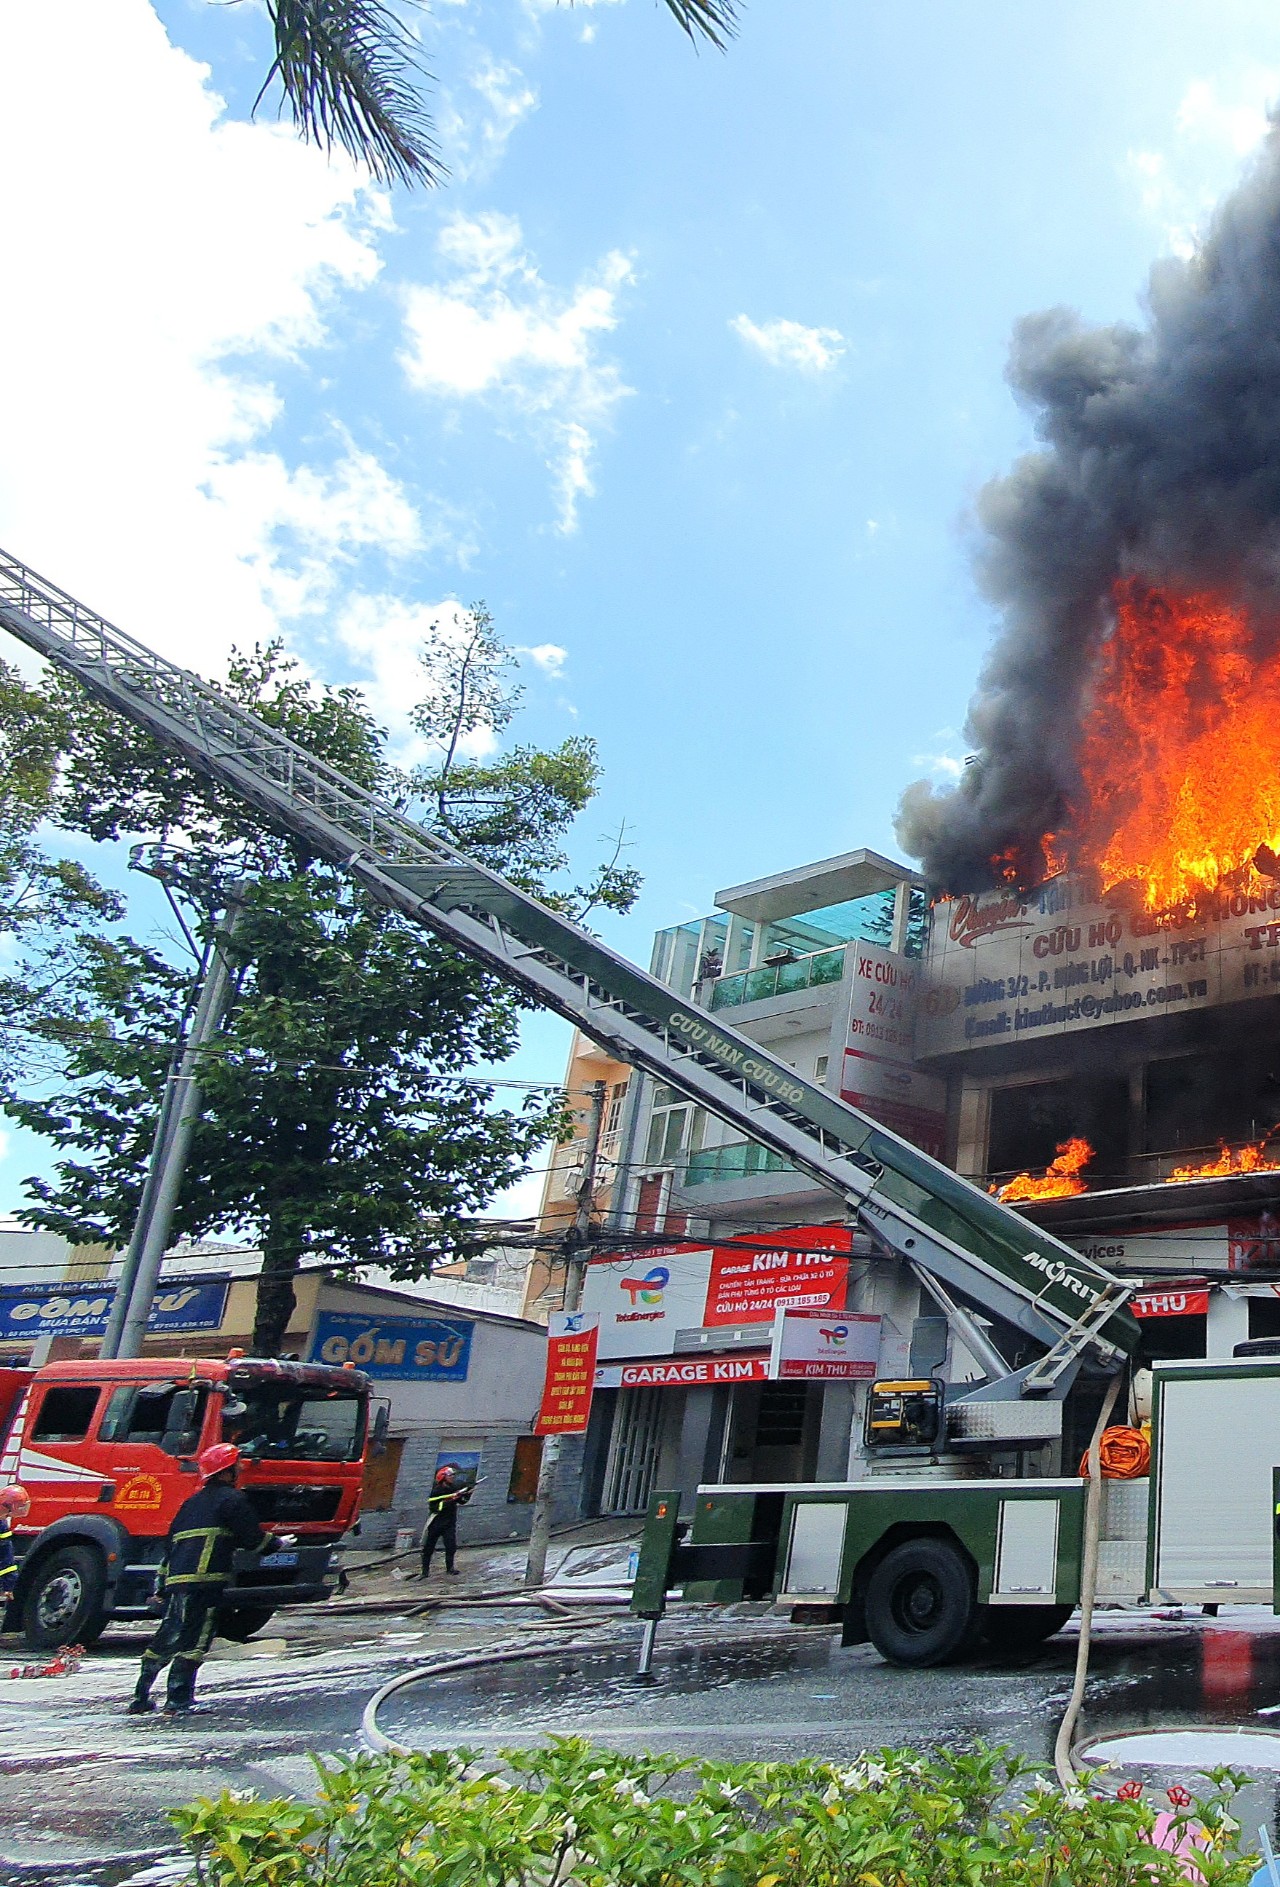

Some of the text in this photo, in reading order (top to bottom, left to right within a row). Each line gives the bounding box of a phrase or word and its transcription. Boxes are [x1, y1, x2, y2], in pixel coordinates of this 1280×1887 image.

[1033, 925, 1081, 959] CỨU
[858, 956, 873, 979] XE
[875, 961, 898, 986] CỨU
[669, 1012, 709, 1040] CỨU
[704, 1035, 744, 1065] NAN
[742, 1059, 780, 1087] CỨU
[720, 1264, 752, 1276] GARAGE
[753, 1251, 789, 1272] KIM
[716, 1298, 773, 1313] CỨU HỘ 24/24
[1136, 1294, 1187, 1315] THU
[38, 1317, 70, 1328] MUA
[71, 1315, 99, 1327] BÁN
[623, 1364, 708, 1384] GARAGE
[714, 1361, 753, 1379] KIM
[805, 1364, 823, 1375] KIM
[826, 1364, 847, 1375] THU
